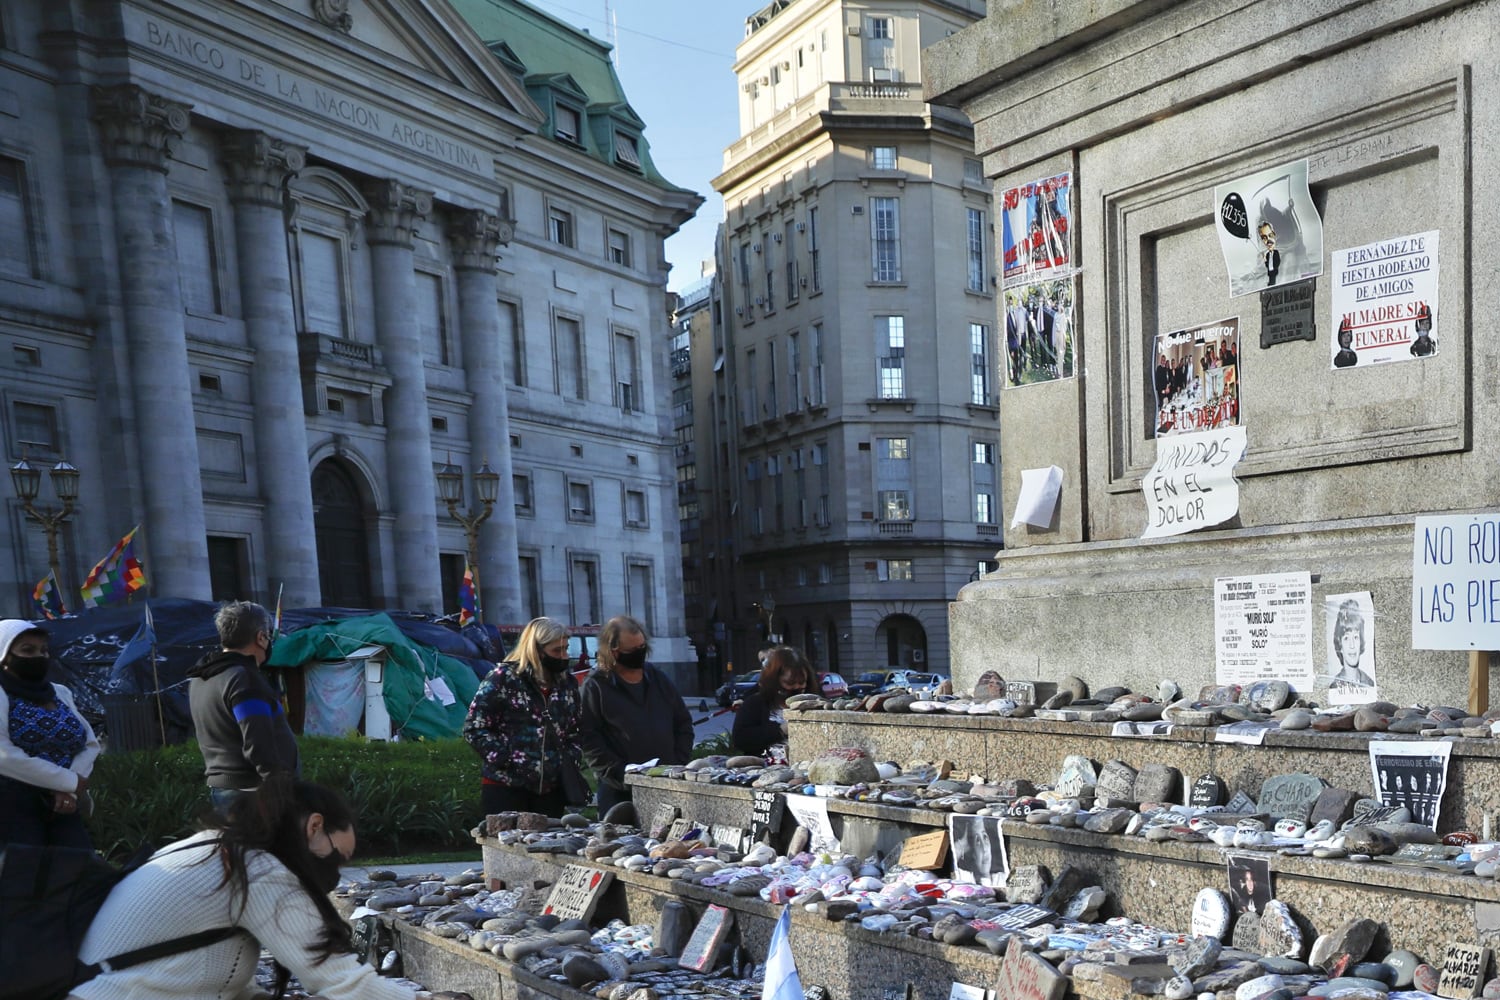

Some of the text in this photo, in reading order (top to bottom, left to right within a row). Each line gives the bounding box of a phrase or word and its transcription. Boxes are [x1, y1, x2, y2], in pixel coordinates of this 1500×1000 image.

[147, 21, 481, 171] BANCO DE LA NACION ARGENTINA
[1347, 237, 1424, 264] FERNÁNDEZ DE
[1342, 256, 1430, 283] FIESTA RODEADO
[1356, 278, 1413, 299] DE AMIGOS
[1343, 311, 1355, 327] MI
[1360, 303, 1403, 324] MADRE
[1206, 326, 1234, 340] error
[1356, 326, 1410, 347] FUNERAL
[1158, 437, 1231, 473] UNIDOS
[1154, 472, 1213, 501] EN EL
[1156, 498, 1205, 528] DOLOR
[1425, 526, 1453, 565] NO
[1420, 583, 1454, 623] LAS
[1443, 960, 1479, 975] ALVAREZ
[1447, 948, 1479, 962] VICTOR
